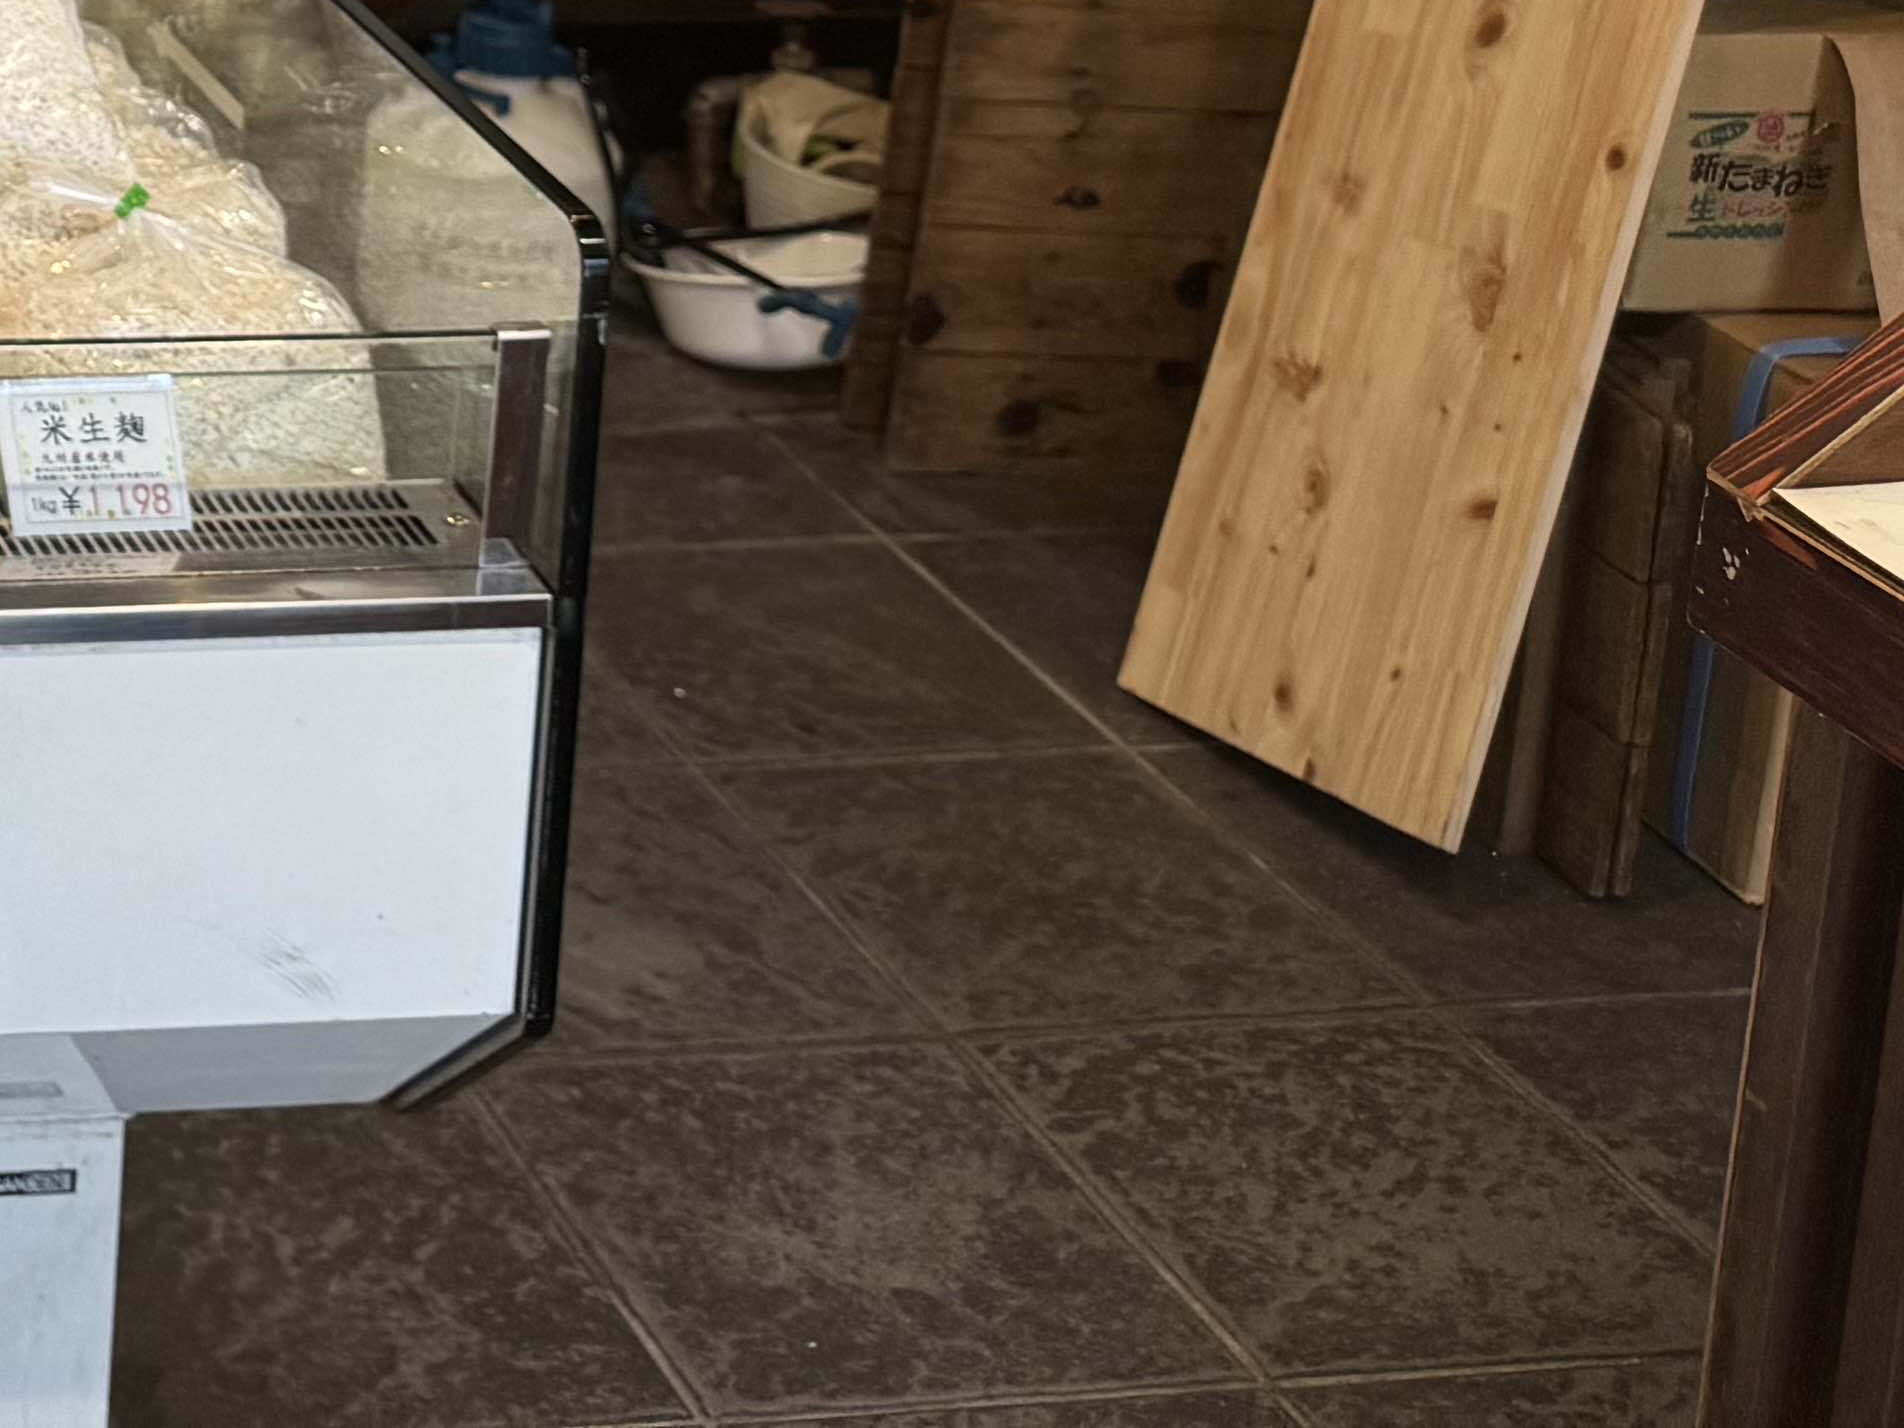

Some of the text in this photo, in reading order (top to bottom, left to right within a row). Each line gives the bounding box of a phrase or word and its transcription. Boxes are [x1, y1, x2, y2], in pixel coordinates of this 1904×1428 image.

[1689, 151, 1833, 197] 新たまねぎ
[40, 411, 147, 445] 米生麹
